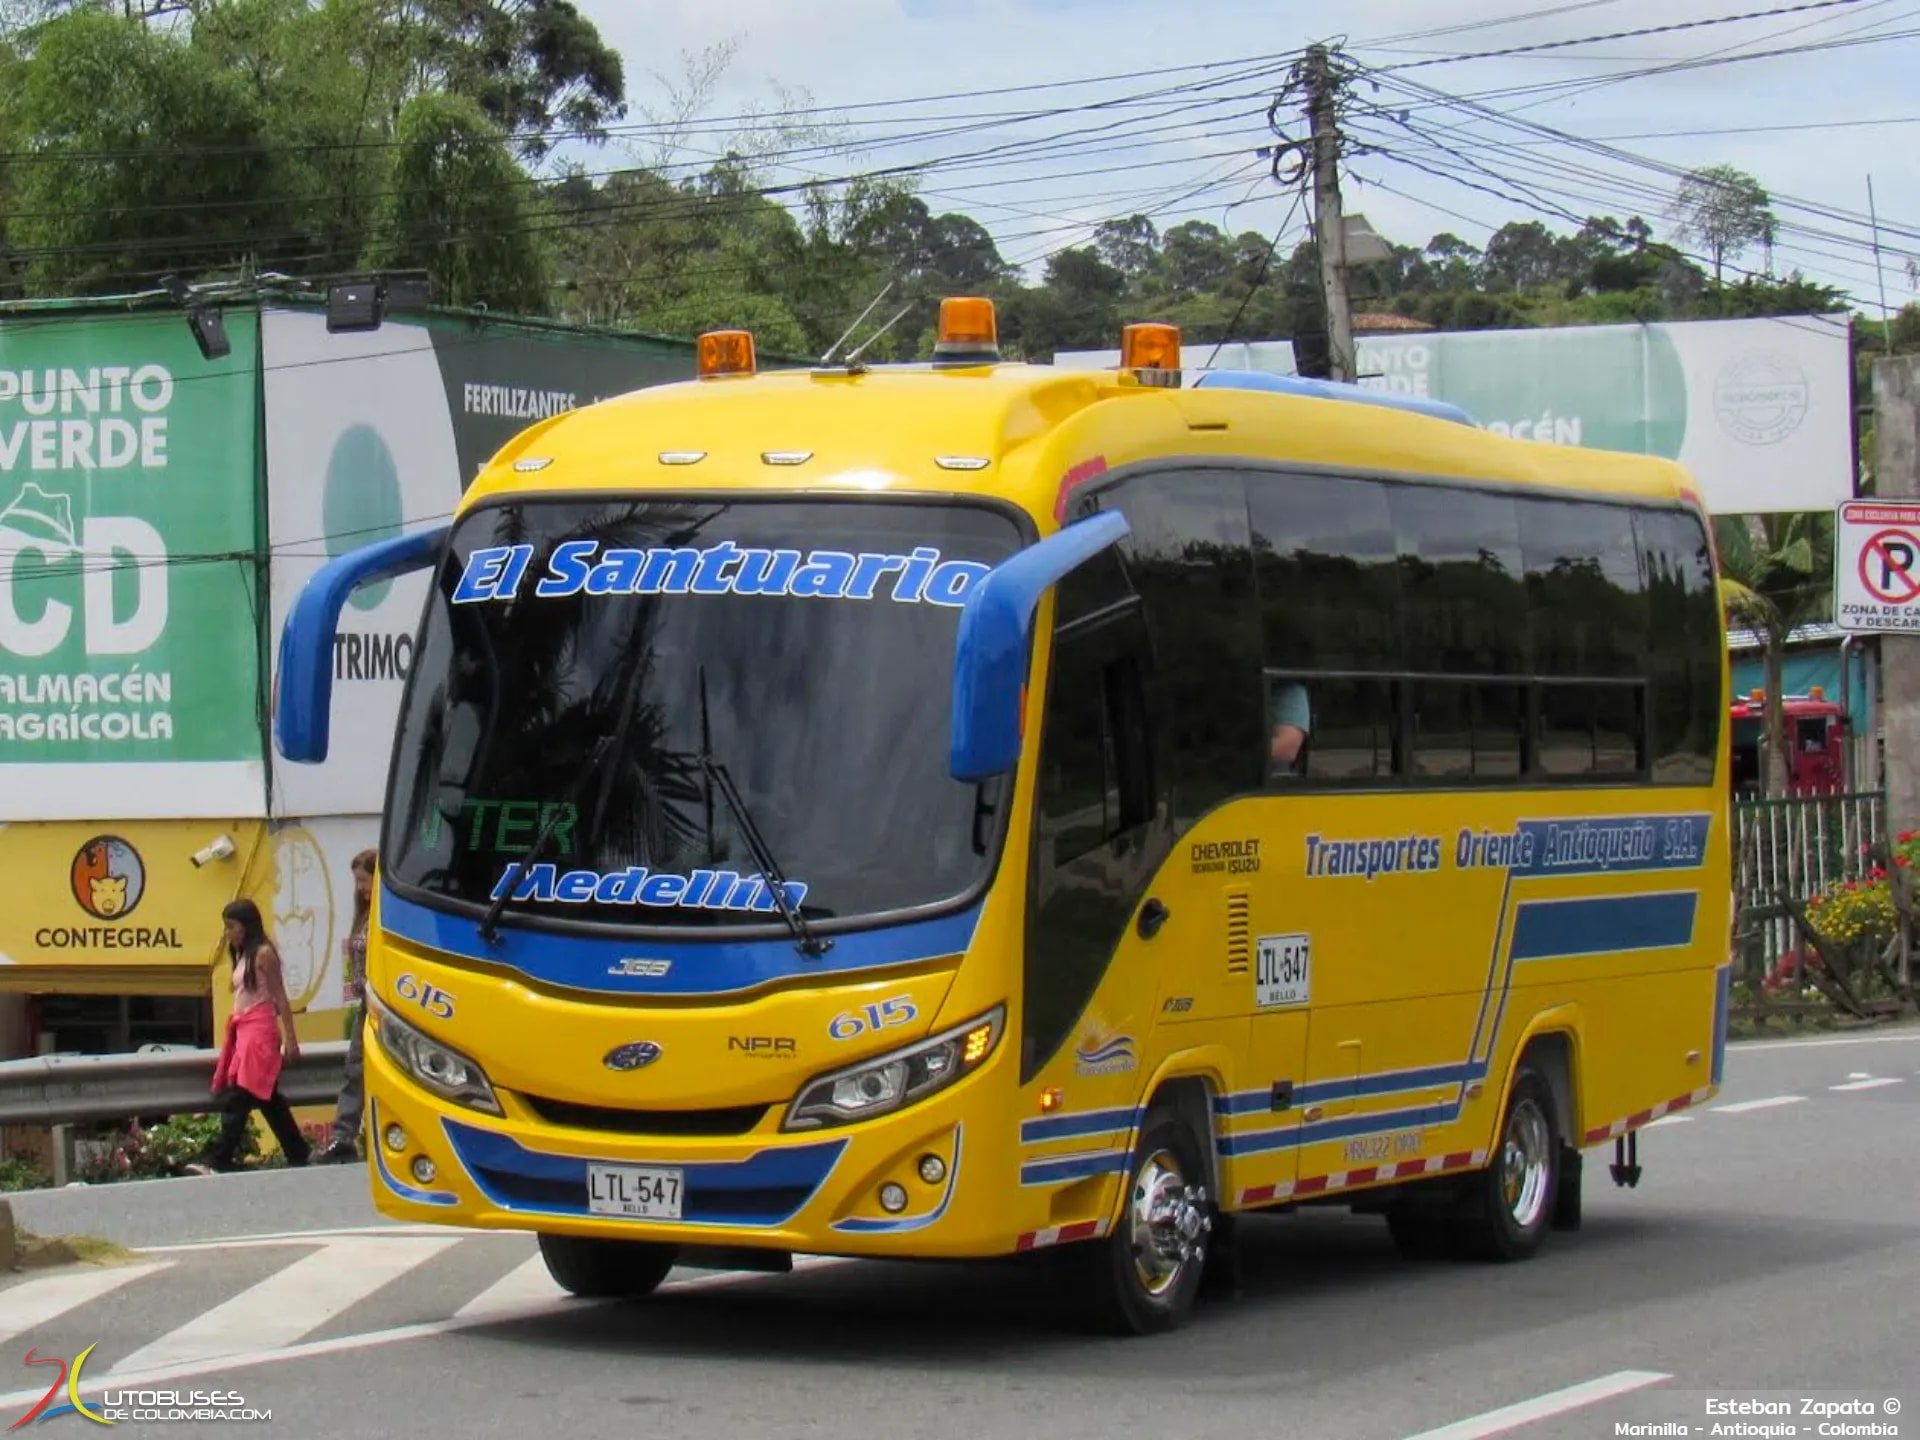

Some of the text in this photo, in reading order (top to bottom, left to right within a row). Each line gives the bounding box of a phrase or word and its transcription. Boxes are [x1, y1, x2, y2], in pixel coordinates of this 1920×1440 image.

[0, 364, 174, 415] PUNTO
[464, 383, 576, 419] FERTILIZANTES
[0, 417, 169, 470] VERDE
[452, 540, 992, 607] El Santuario
[1842, 604, 1877, 615] ZONA
[1883, 606, 1899, 616] DE
[1853, 617, 1861, 626] Y
[0, 664, 171, 704] ALMACÉN
[0, 704, 173, 740] AGRÍCOLA
[1191, 839, 1260, 861] CHEVROLET
[1227, 858, 1260, 874] ISUZU
[1304, 818, 1697, 883] Transportes Oriente Antioqueño S.A.
[35, 927, 183, 949] CONTEGRAL
[395, 972, 458, 1019] 615
[1269, 989, 1297, 1002] BELLO
[828, 994, 918, 1040] 615
[728, 1036, 796, 1052] NPR
